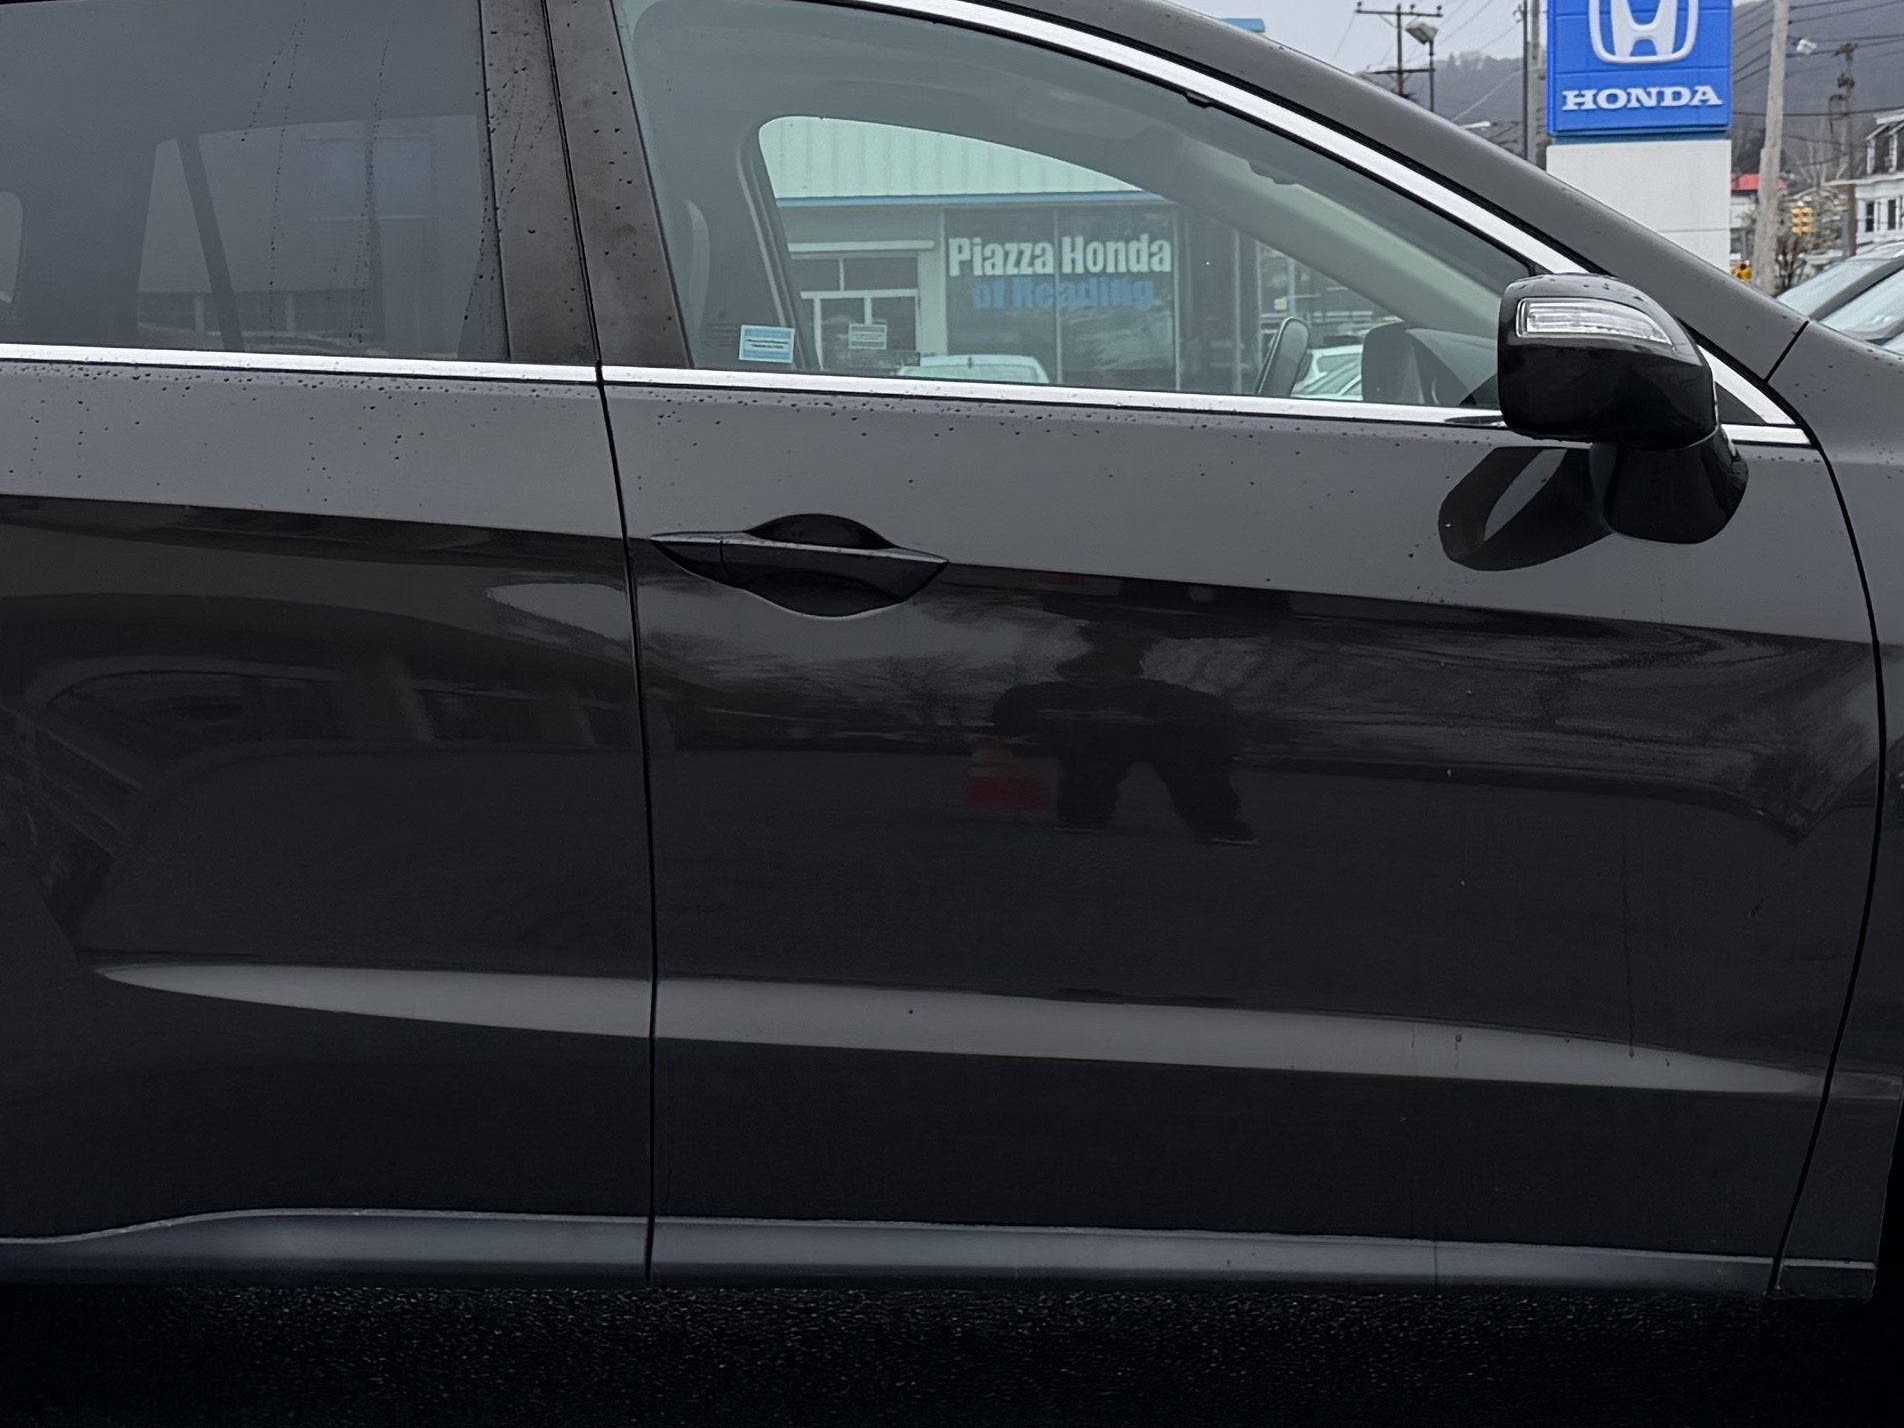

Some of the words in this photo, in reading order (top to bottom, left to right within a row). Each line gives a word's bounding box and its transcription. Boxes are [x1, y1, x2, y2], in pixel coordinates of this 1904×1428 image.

[1562, 85, 1724, 112] HONDA
[949, 237, 1055, 277] Piazza
[1061, 233, 1172, 274] Honda
[974, 278, 1006, 310] of
[1012, 276, 1155, 311] Reading
